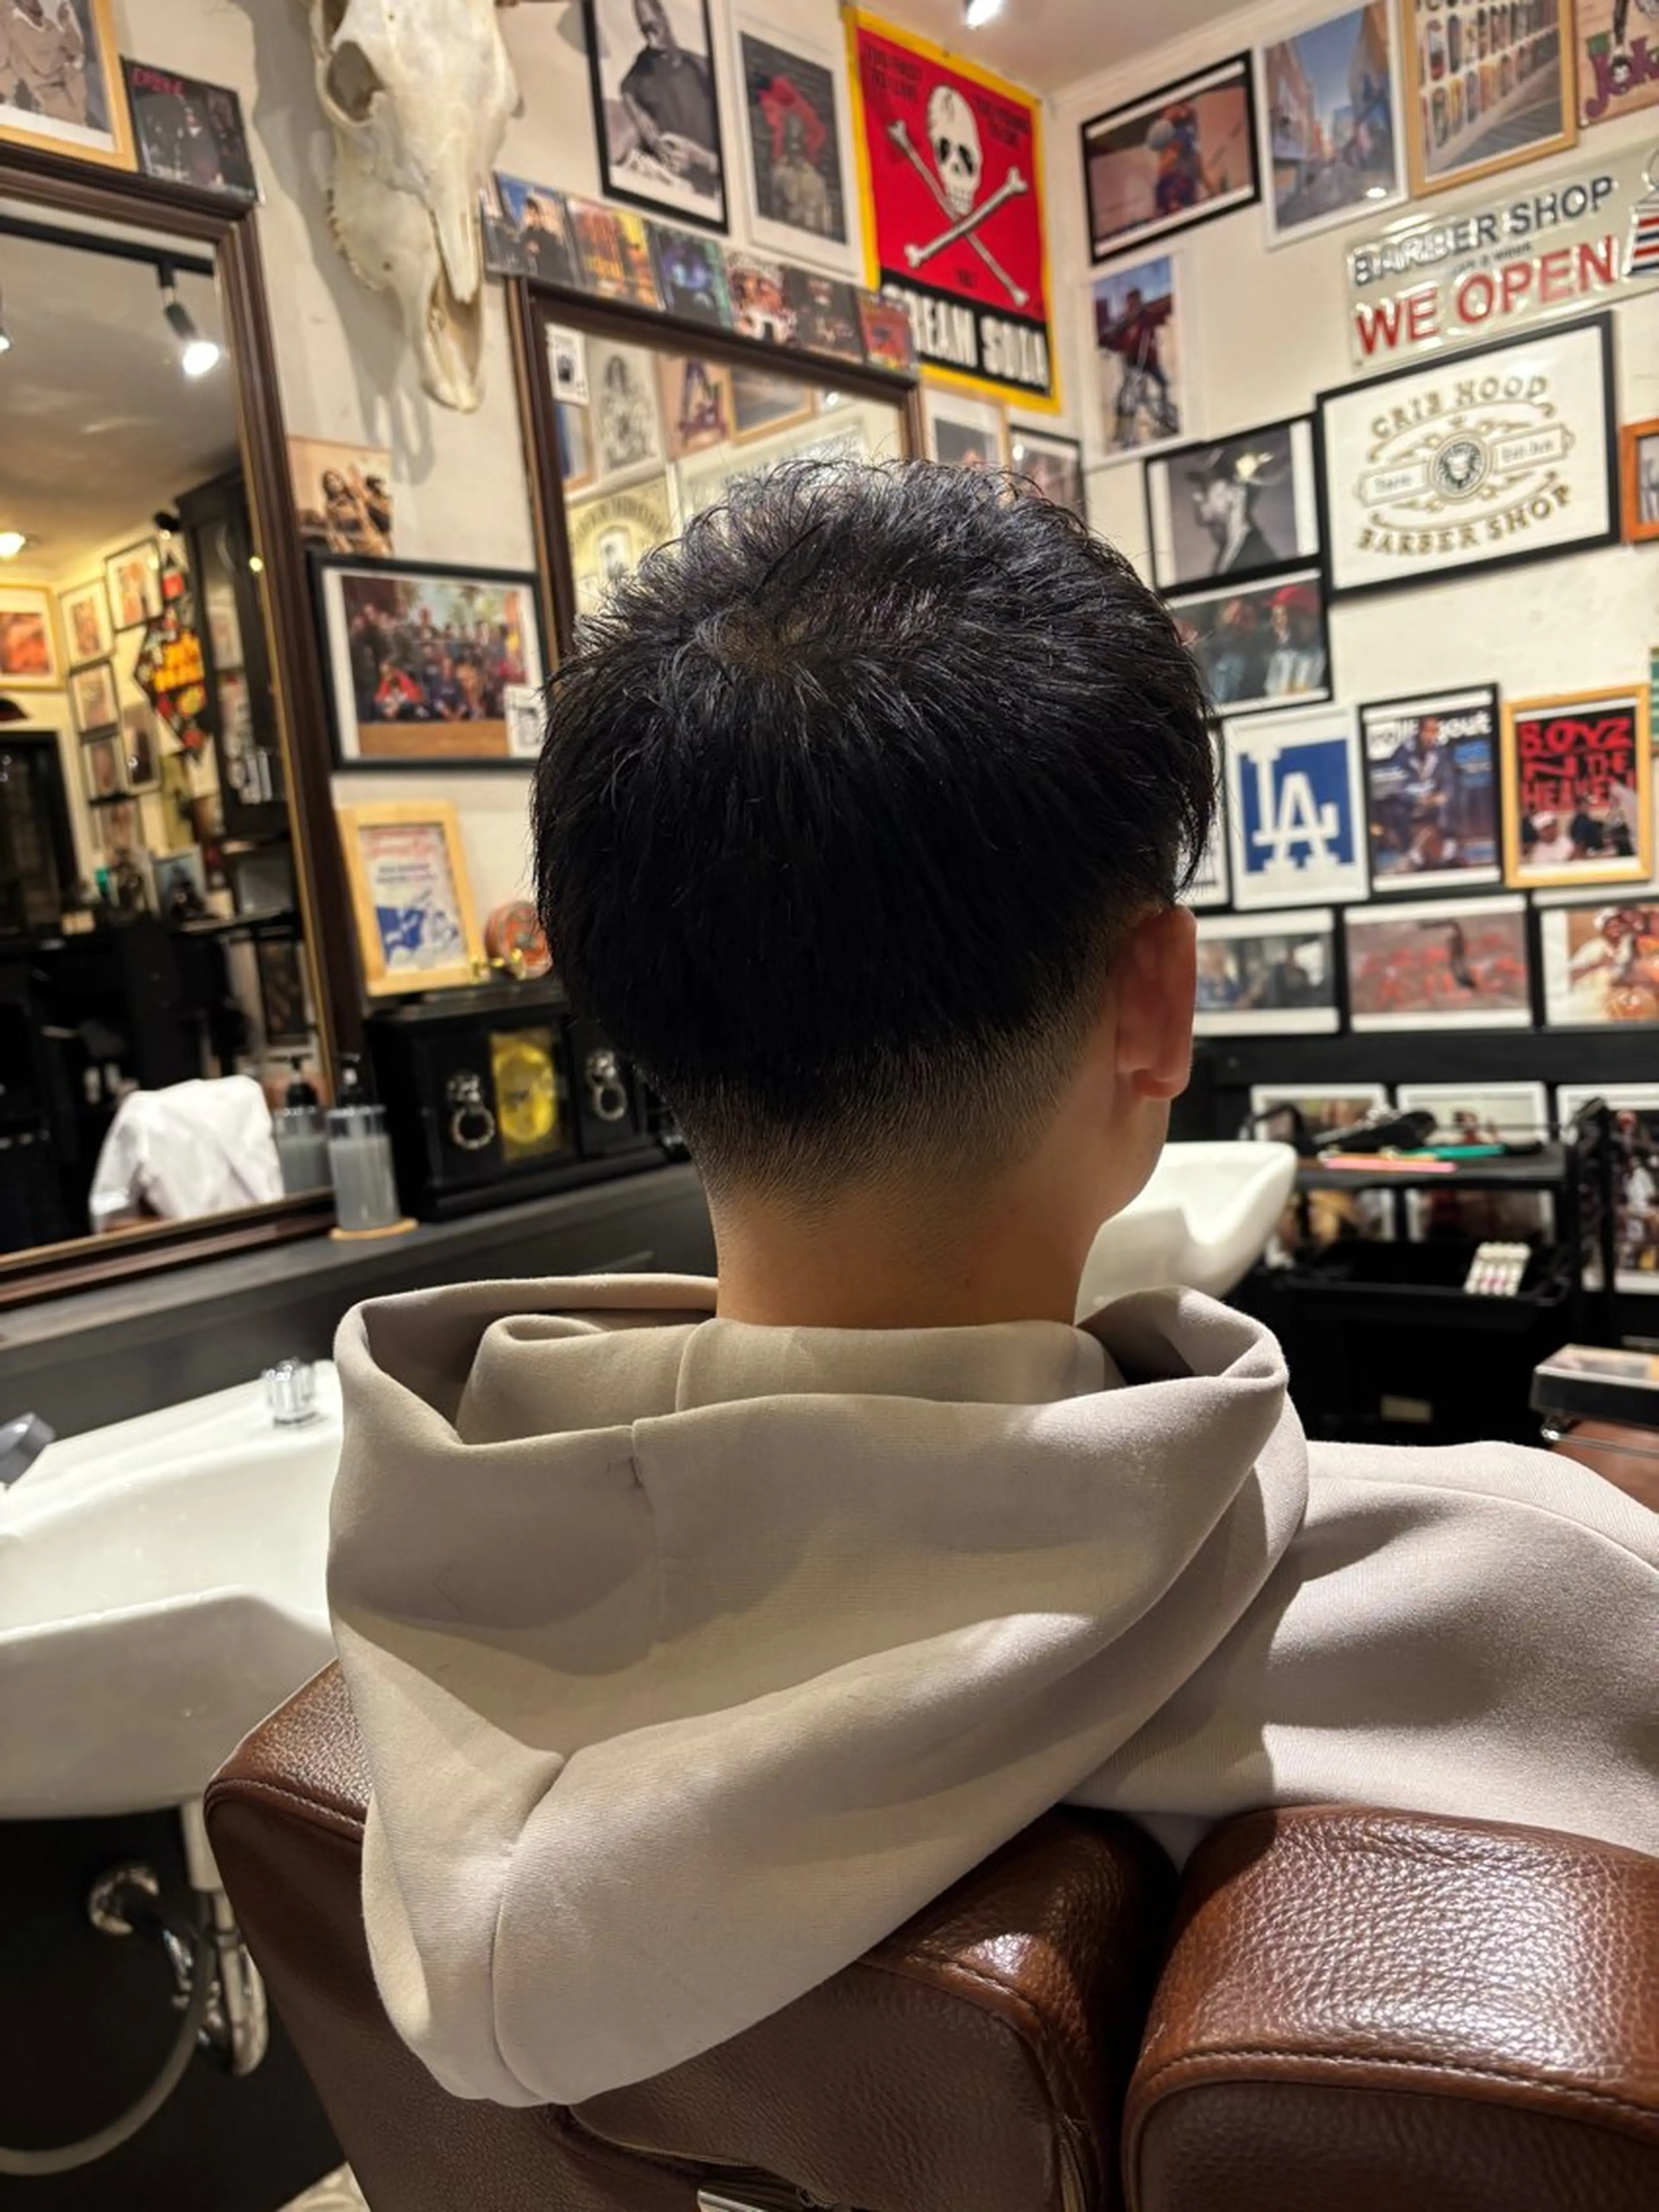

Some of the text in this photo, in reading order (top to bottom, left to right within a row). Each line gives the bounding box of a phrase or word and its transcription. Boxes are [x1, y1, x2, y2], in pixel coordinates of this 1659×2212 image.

[1355, 214, 1498, 287] BARBER
[1510, 175, 1613, 232] SHOP
[1356, 286, 1440, 355] WE
[1456, 233, 1614, 325] OPEN
[1454, 375, 1548, 406] HOOD
[1357, 484, 1570, 556] BARBER SHOP
[1519, 715, 1633, 757] BOYZ
[1248, 747, 1340, 871] LA
